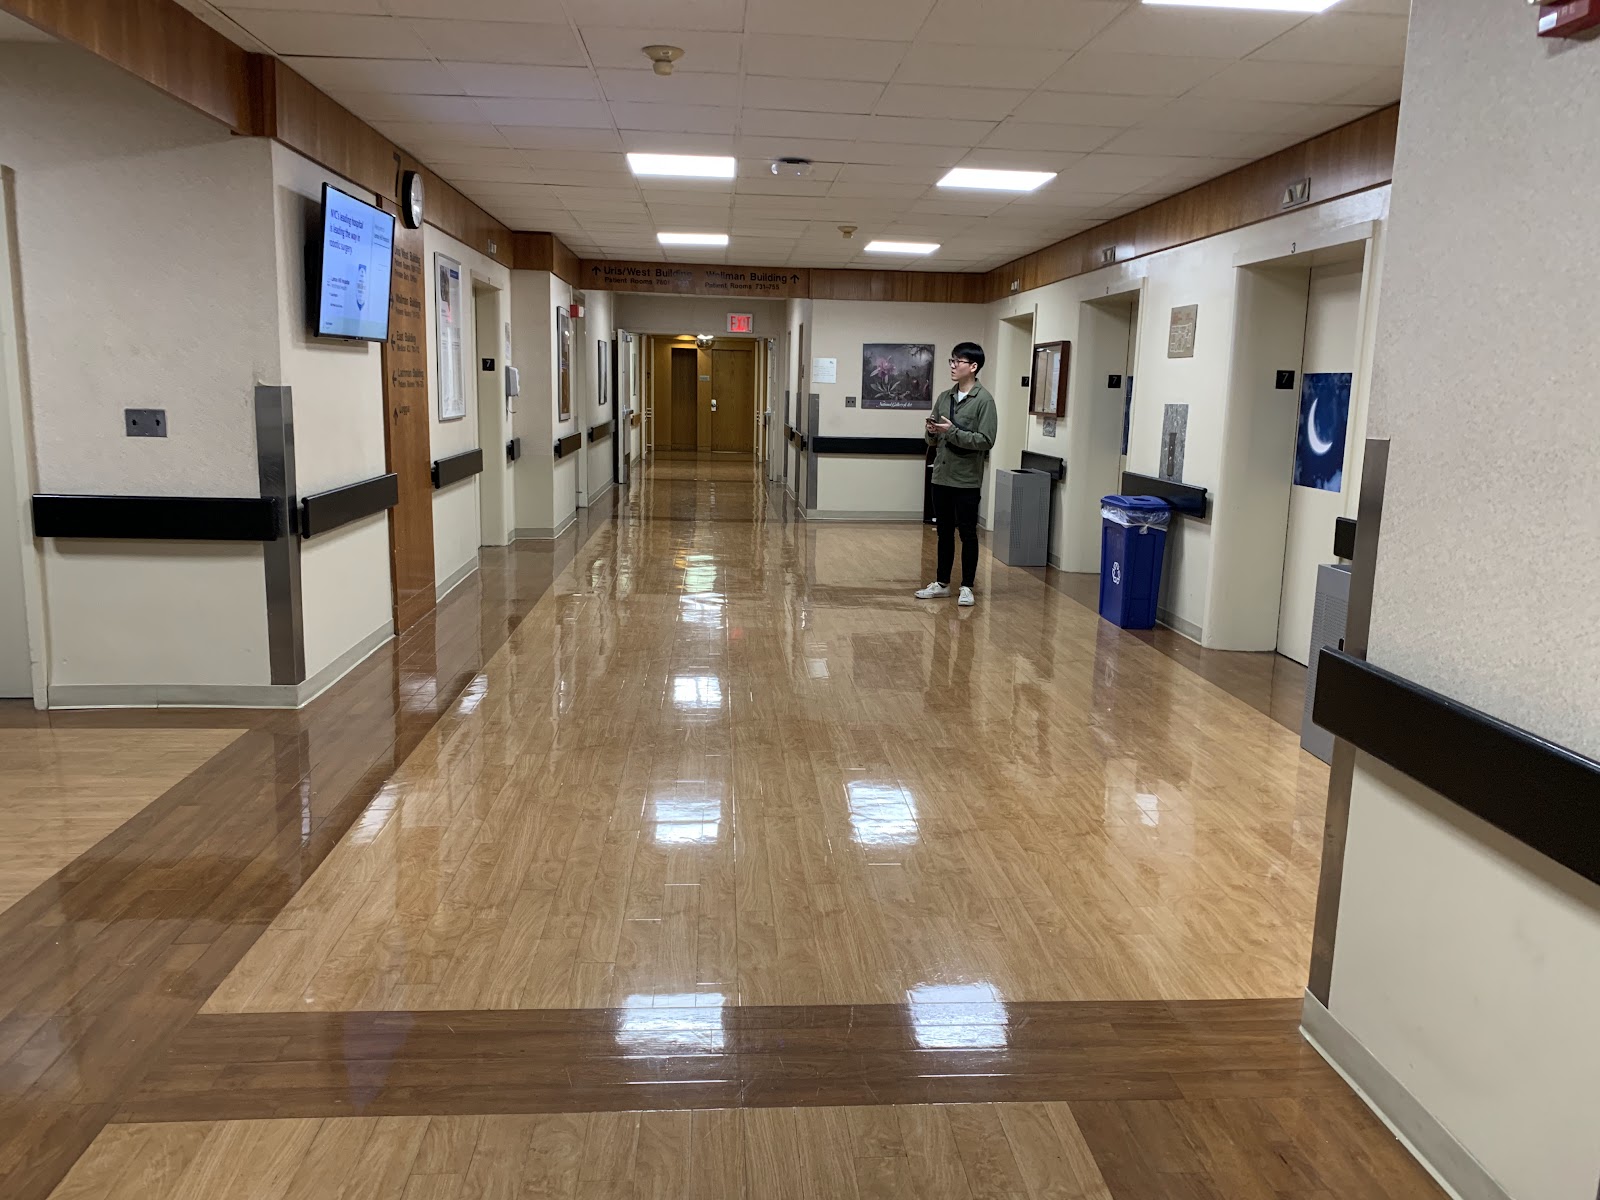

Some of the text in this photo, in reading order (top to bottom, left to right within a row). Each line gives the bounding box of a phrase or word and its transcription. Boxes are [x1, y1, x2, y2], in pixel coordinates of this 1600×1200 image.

[410, 251, 421, 267] Building
[604, 266, 692, 281] Uris/West Building
[604, 276, 627, 284] Patient
[705, 271, 787, 285] Wellman Building
[730, 315, 752, 332] EXIT
[1282, 372, 1289, 384] 7
